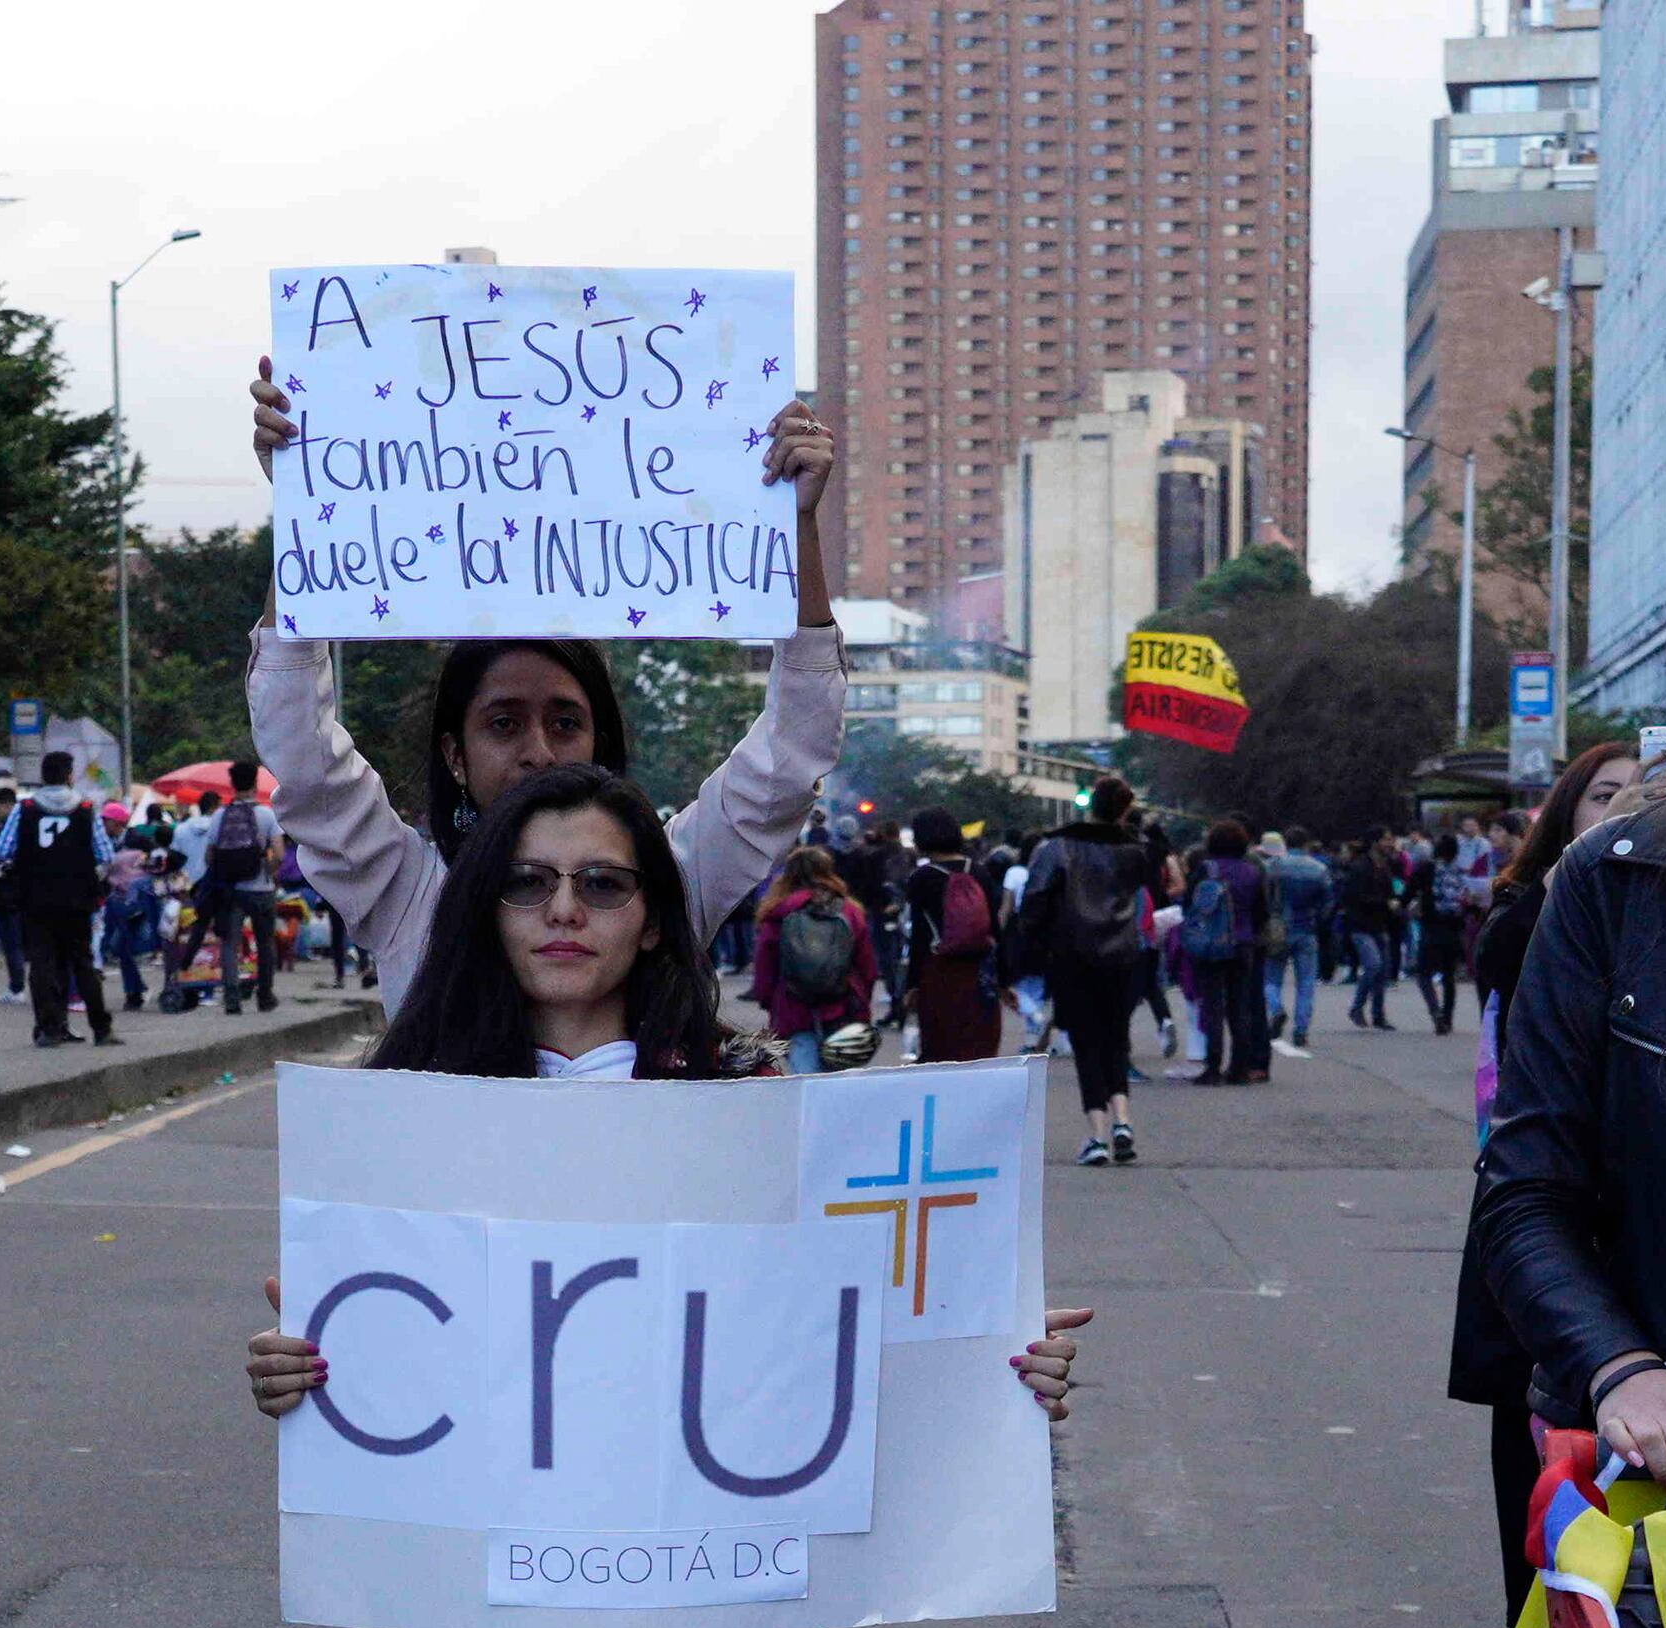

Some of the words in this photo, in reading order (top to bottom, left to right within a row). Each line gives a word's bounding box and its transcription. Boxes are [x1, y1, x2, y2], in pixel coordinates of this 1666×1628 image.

[308, 275, 372, 351] A
[411, 315, 685, 409] JESÚS
[289, 408, 579, 497] también
[623, 417, 694, 499] le
[276, 503, 428, 596] duele
[457, 502, 508, 590] la
[534, 516, 798, 599] INJUSTICIA
[304, 1256, 860, 1499] cru
[508, 1532, 718, 1585] BOGOTÁ
